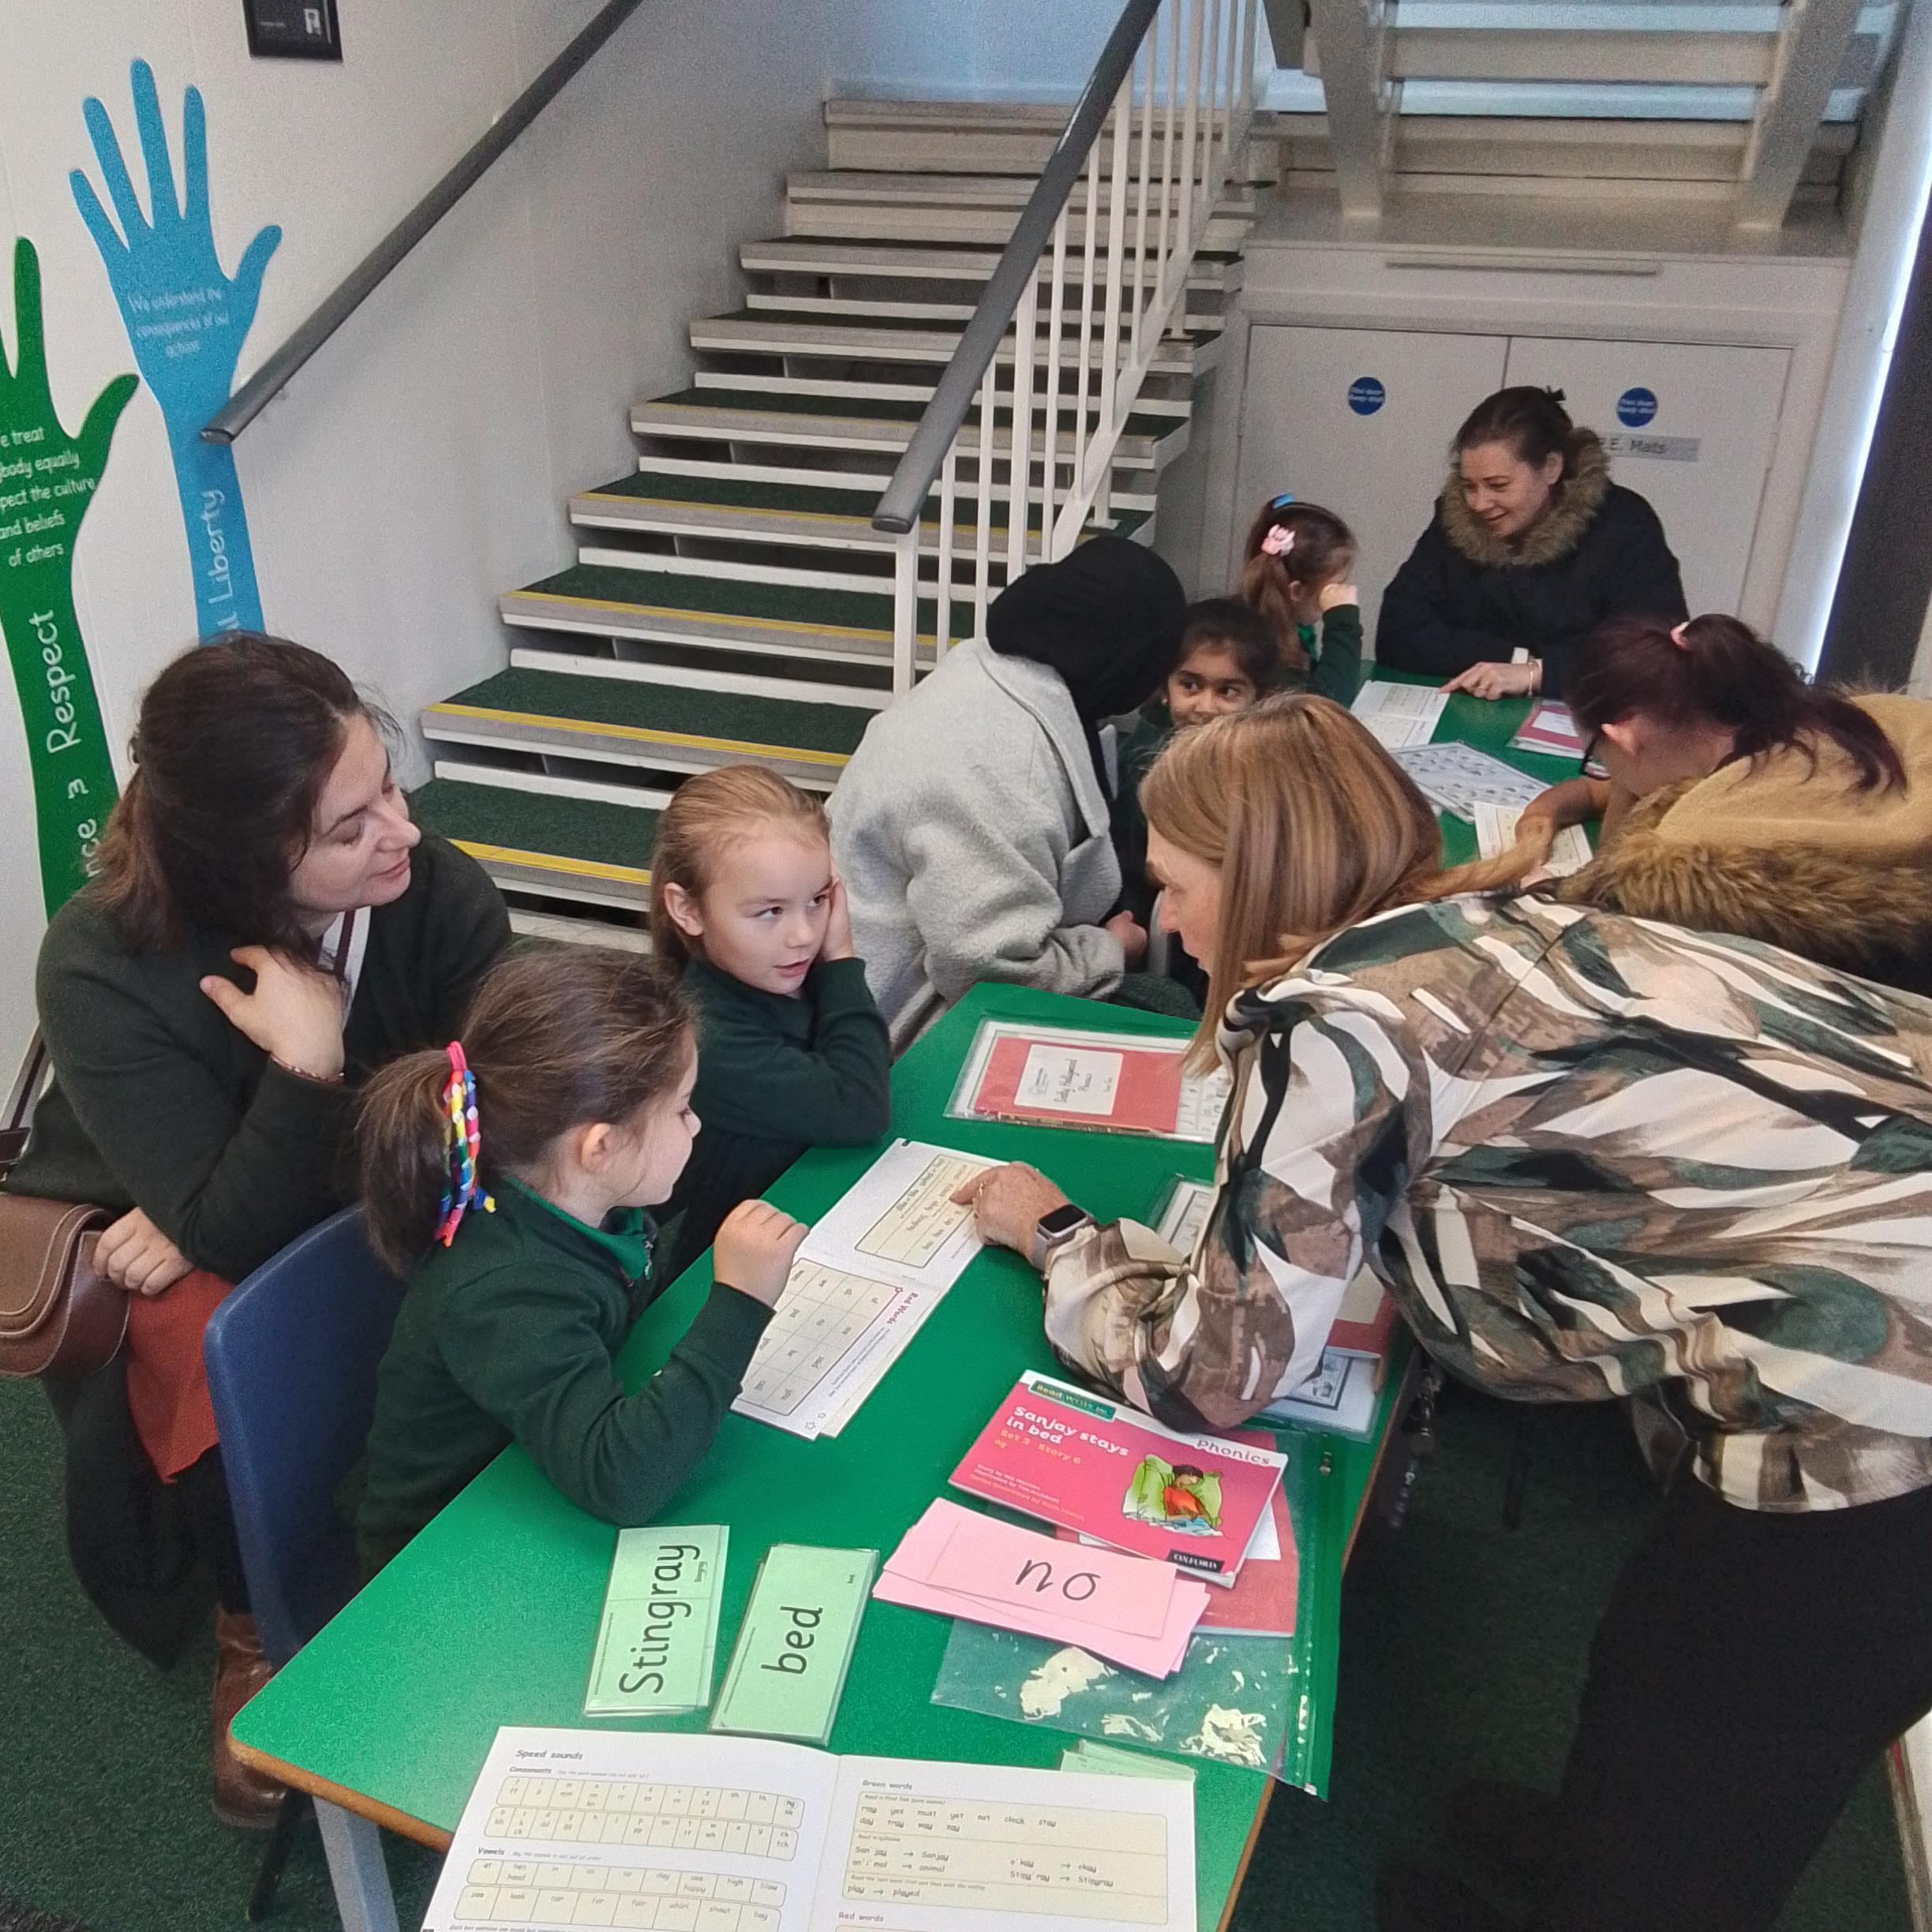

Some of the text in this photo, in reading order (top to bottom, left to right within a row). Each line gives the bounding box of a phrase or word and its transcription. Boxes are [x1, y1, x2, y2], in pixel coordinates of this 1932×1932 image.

[11, 425, 45, 446] treat
[35, 449, 80, 474] equally
[30, 485, 52, 503] the
[24, 508, 66, 534] beliefs
[8, 543, 65, 567] of others
[201, 489, 234, 604] Liberty
[28, 609, 82, 754] Respect
[1036, 1384, 1062, 1398] Read
[1000, 1428, 1020, 1441] Set
[1013, 1406, 1129, 1457] Sanjay stays
[1028, 1424, 1064, 1444] bed
[1016, 1557, 1103, 1602] no
[618, 1544, 701, 1694] Stingray
[760, 1605, 824, 1676] bed
[515, 1749, 584, 1761] Speed sounds
[862, 1779, 912, 1791] Green words
[859, 1817, 874, 1826] day
[887, 1818, 905, 1829] tray
[917, 1822, 934, 1831] way
[1038, 1818, 1056, 1828] stay
[477, 1846, 505, 1856] Vowels
[921, 1851, 949, 1862] Sanjay
[656, 1871, 670, 1881] day
[726, 1877, 743, 1888] high
[760, 1881, 778, 1892] blow
[919, 1863, 945, 1874] animal
[1078, 1876, 1114, 1889] Stingray
[683, 1884, 706, 1894] happy
[847, 1884, 921, 1899] play played
[709, 1904, 731, 1915] shout
[837, 1911, 885, 1923] Red words
